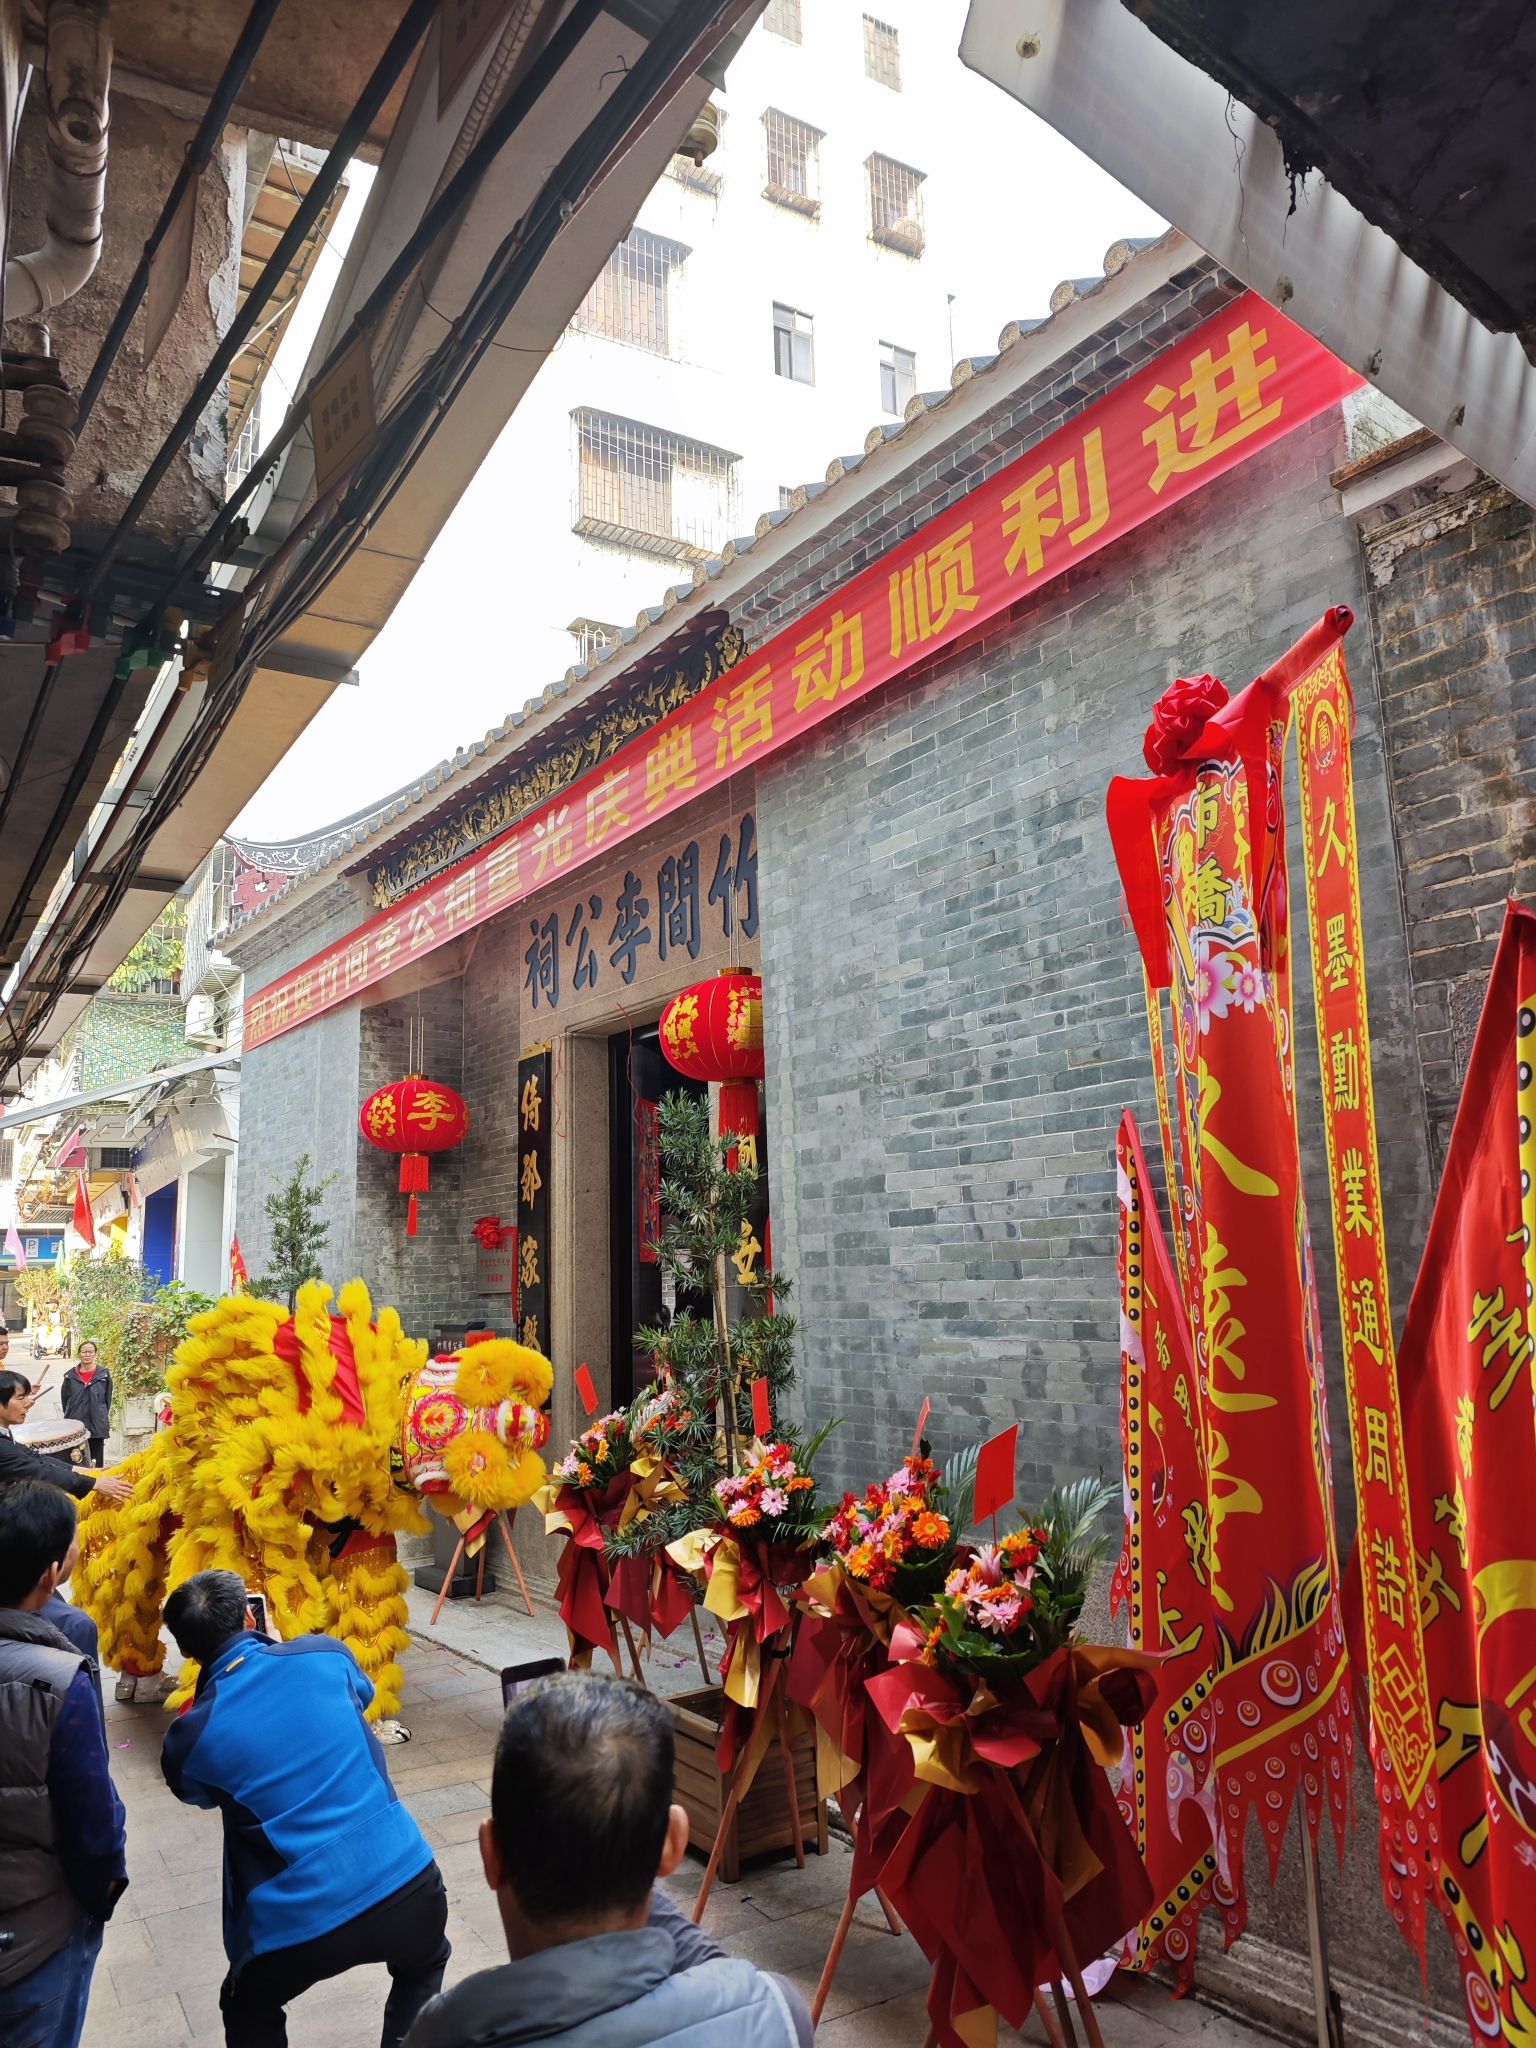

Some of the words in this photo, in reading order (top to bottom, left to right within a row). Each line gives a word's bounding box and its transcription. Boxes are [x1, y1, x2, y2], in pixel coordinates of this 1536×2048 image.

[250, 321, 1355, 1042] 烈祝贺竹间李公祠重光庆典活动顺利进
[524, 812, 760, 1010] 竹間李公祠
[407, 1090, 455, 1131] 李
